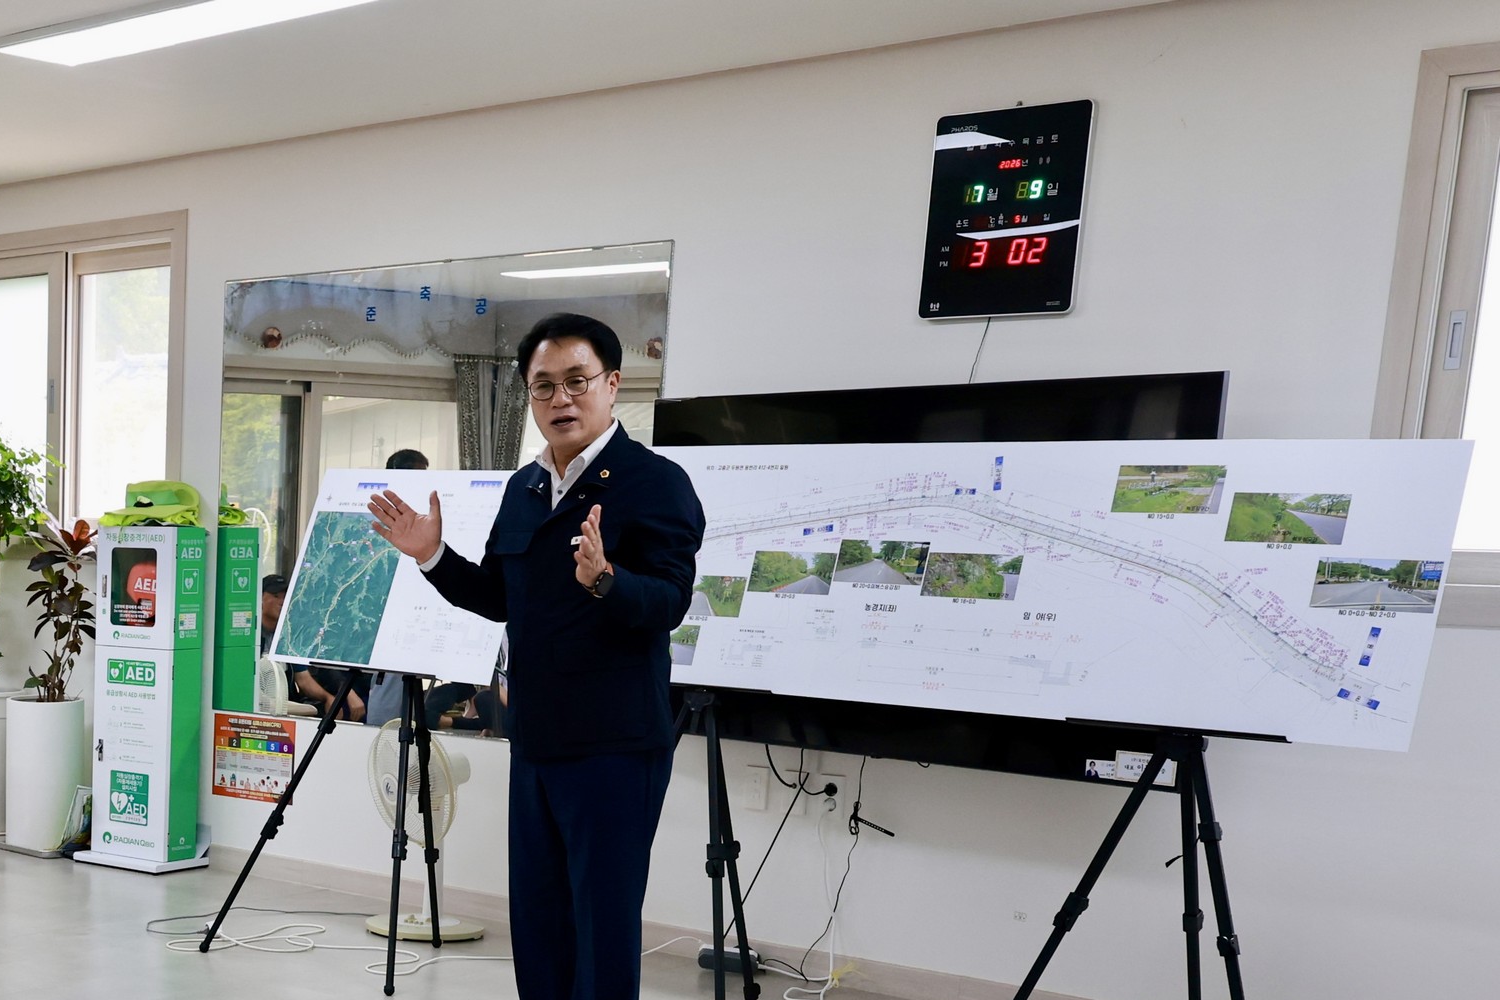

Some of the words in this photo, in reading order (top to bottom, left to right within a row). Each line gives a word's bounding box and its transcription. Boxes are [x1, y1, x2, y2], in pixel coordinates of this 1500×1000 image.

[181, 547, 202, 559] AED
[125, 666, 155, 682] AED
[270, 743, 275, 751] 5
[125, 802, 147, 816] AED
